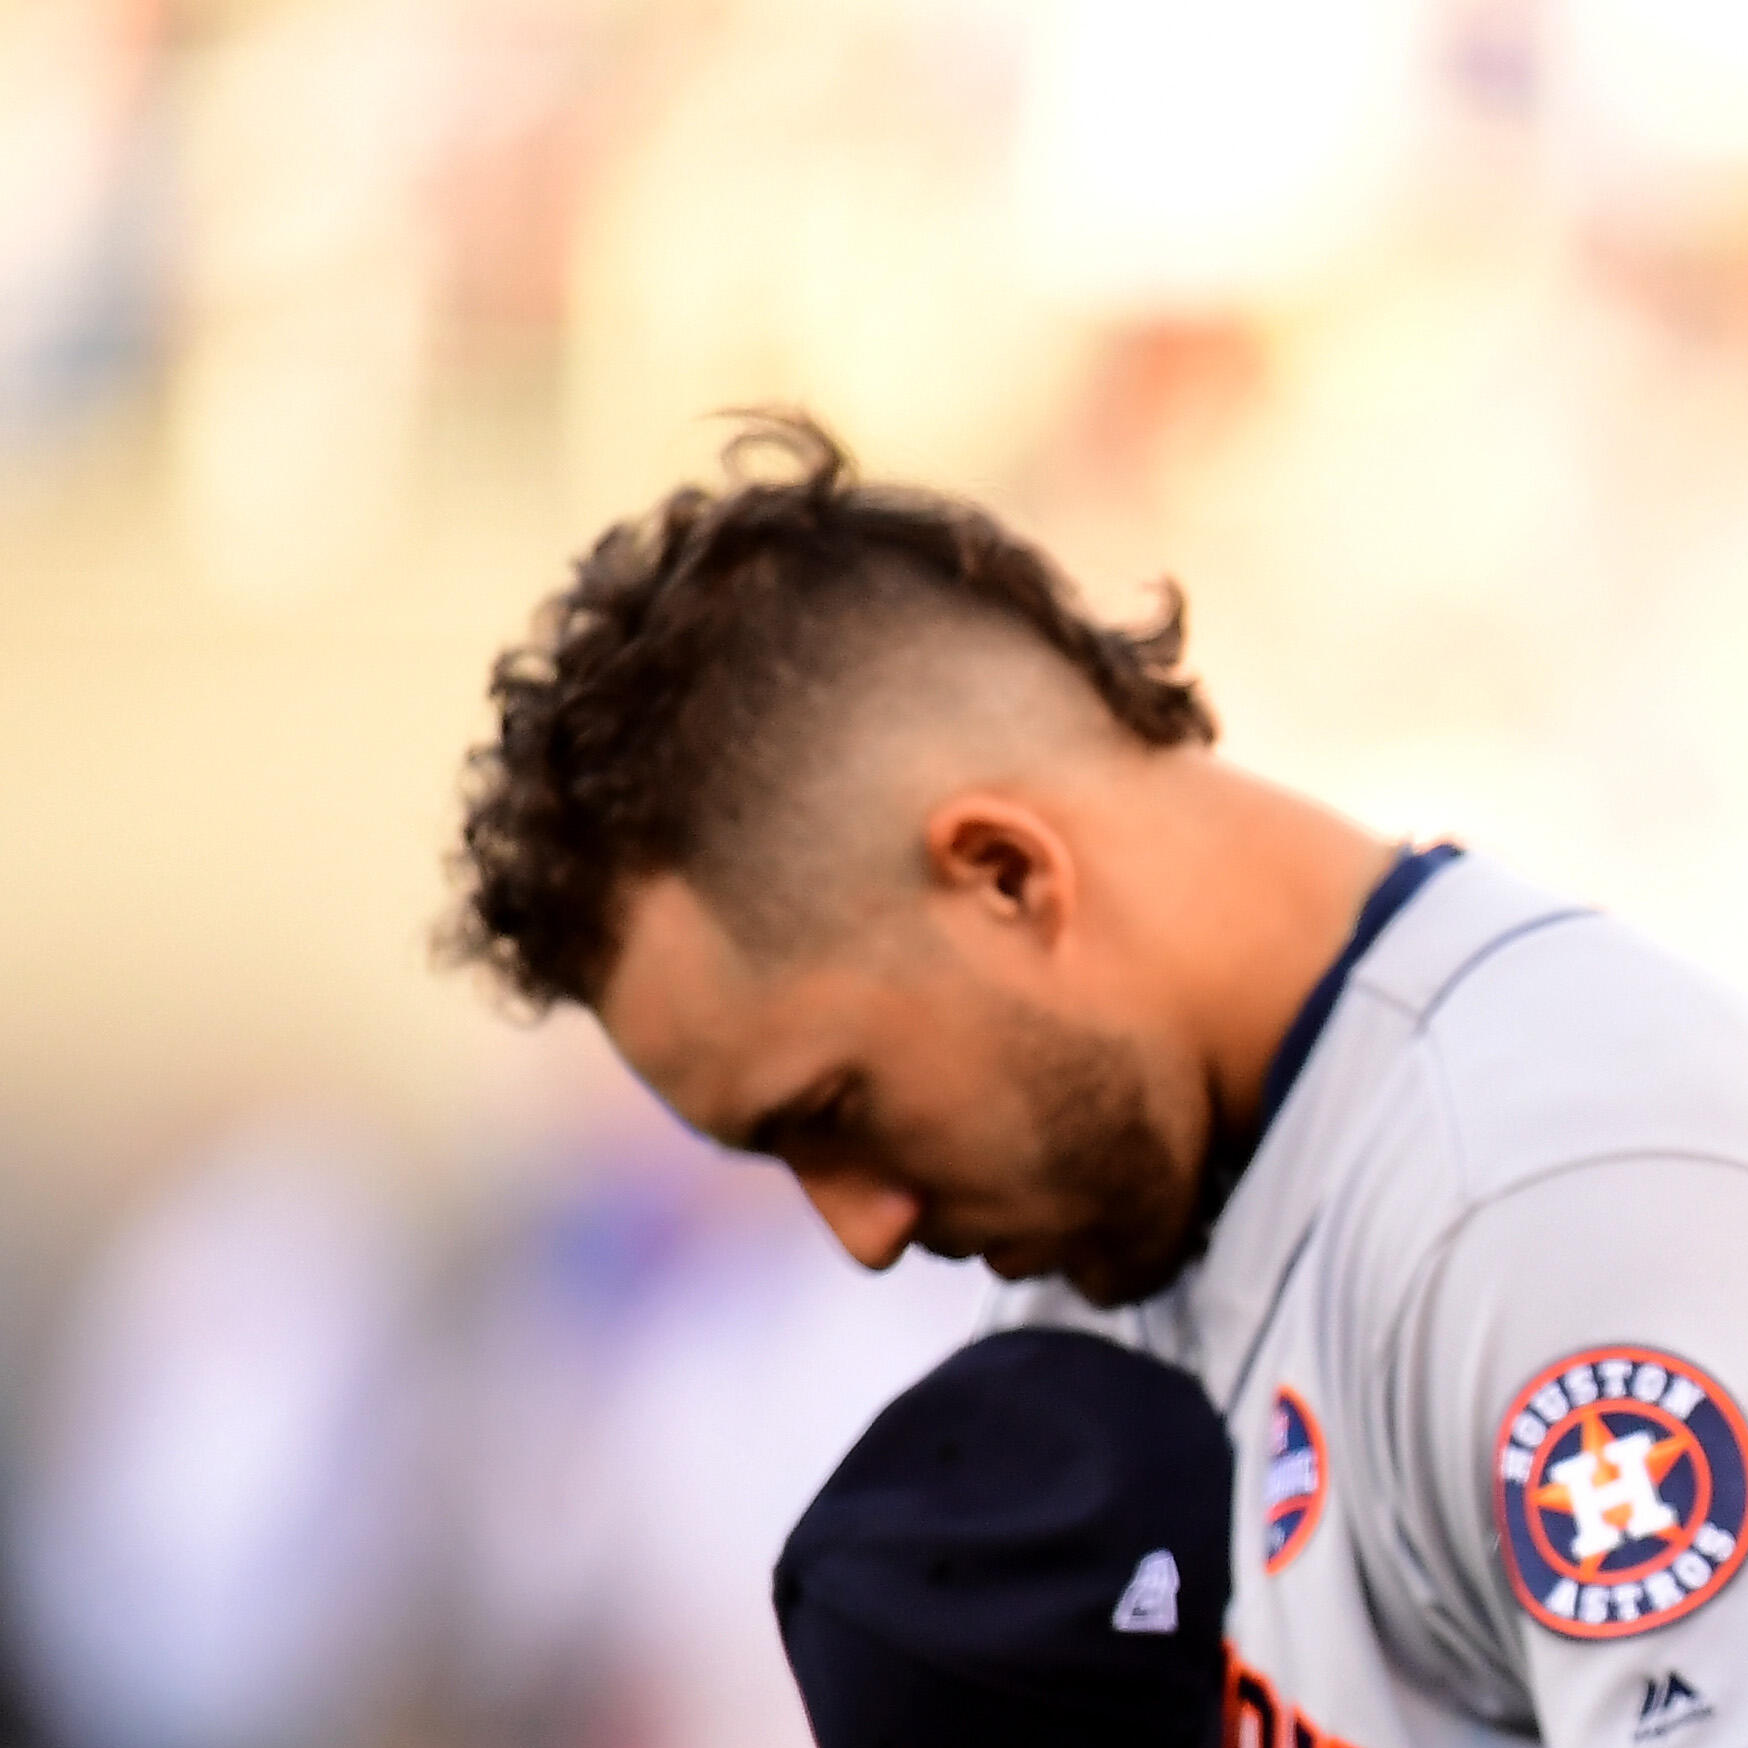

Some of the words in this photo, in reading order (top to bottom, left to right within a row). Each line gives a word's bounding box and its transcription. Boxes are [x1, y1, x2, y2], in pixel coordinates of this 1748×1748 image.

[1501, 1357, 1706, 1484] HOUSTON
[1549, 1430, 1676, 1559] H
[1546, 1522, 1737, 1634] ASTROS
